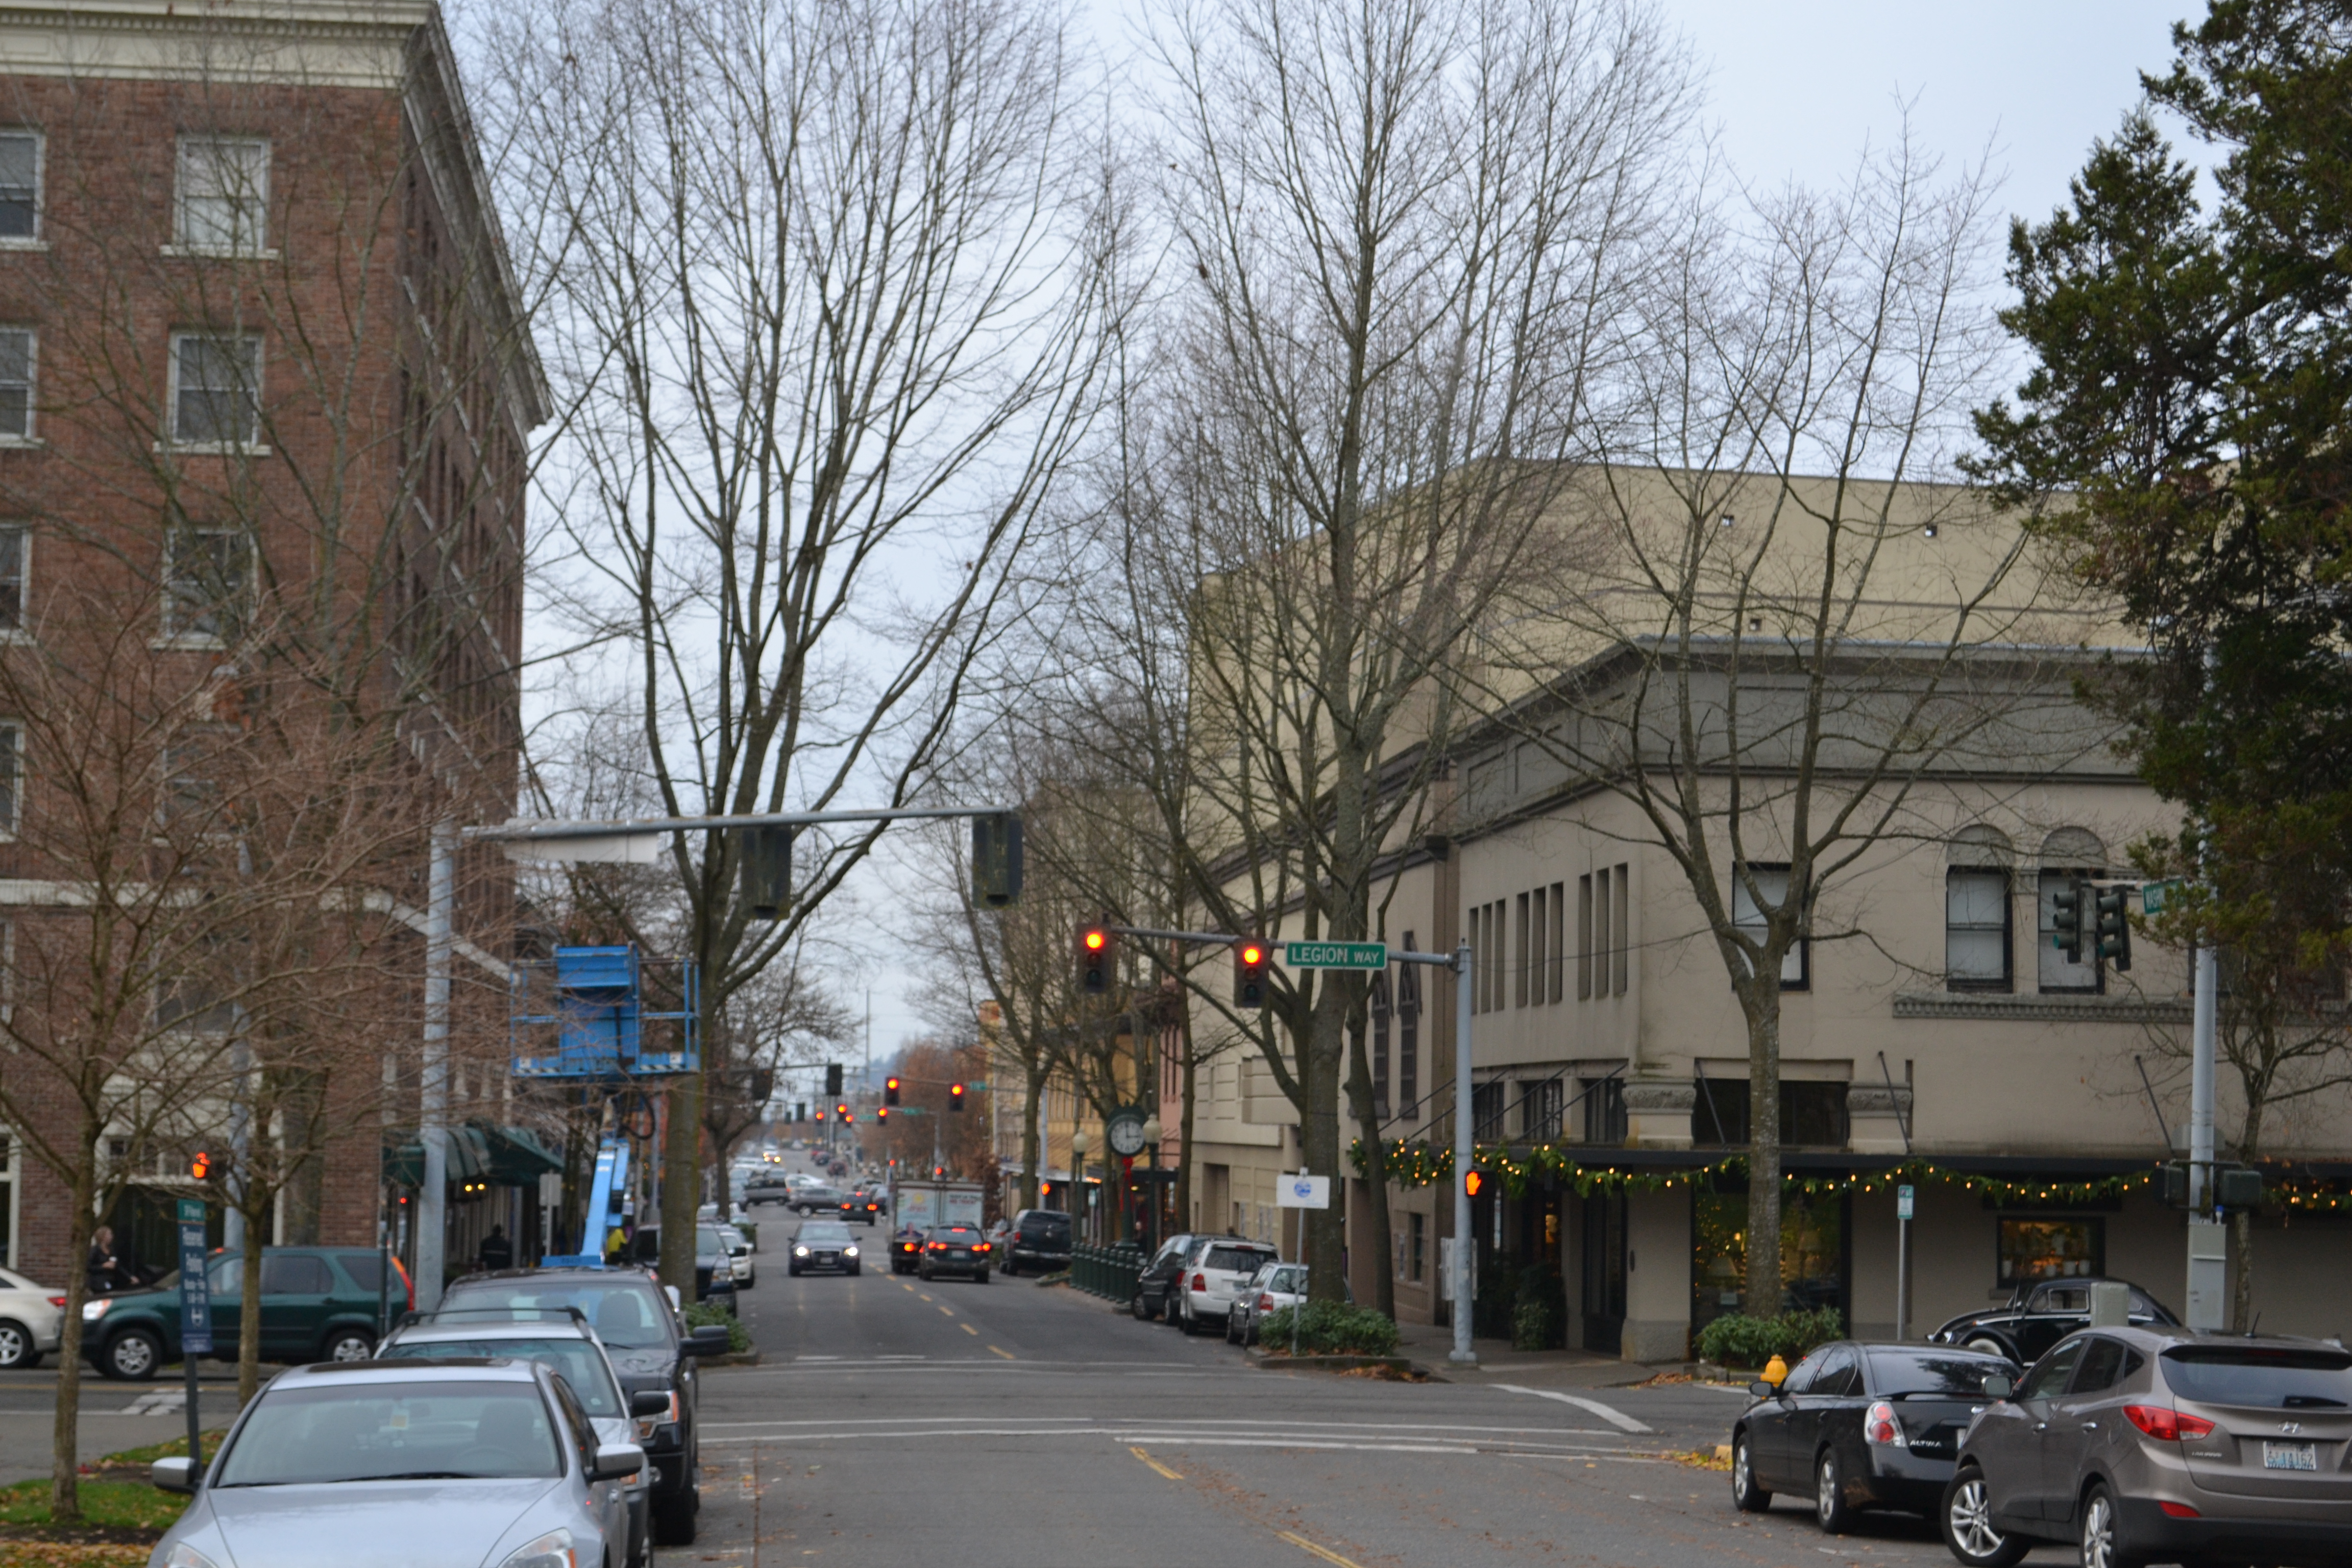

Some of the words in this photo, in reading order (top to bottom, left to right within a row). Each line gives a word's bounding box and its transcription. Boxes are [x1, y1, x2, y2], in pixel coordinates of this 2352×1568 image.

[1291, 946, 1348, 963] LEGION
[1354, 951, 1379, 964] WAY
[1909, 1439, 1942, 1448] ALTIMA
